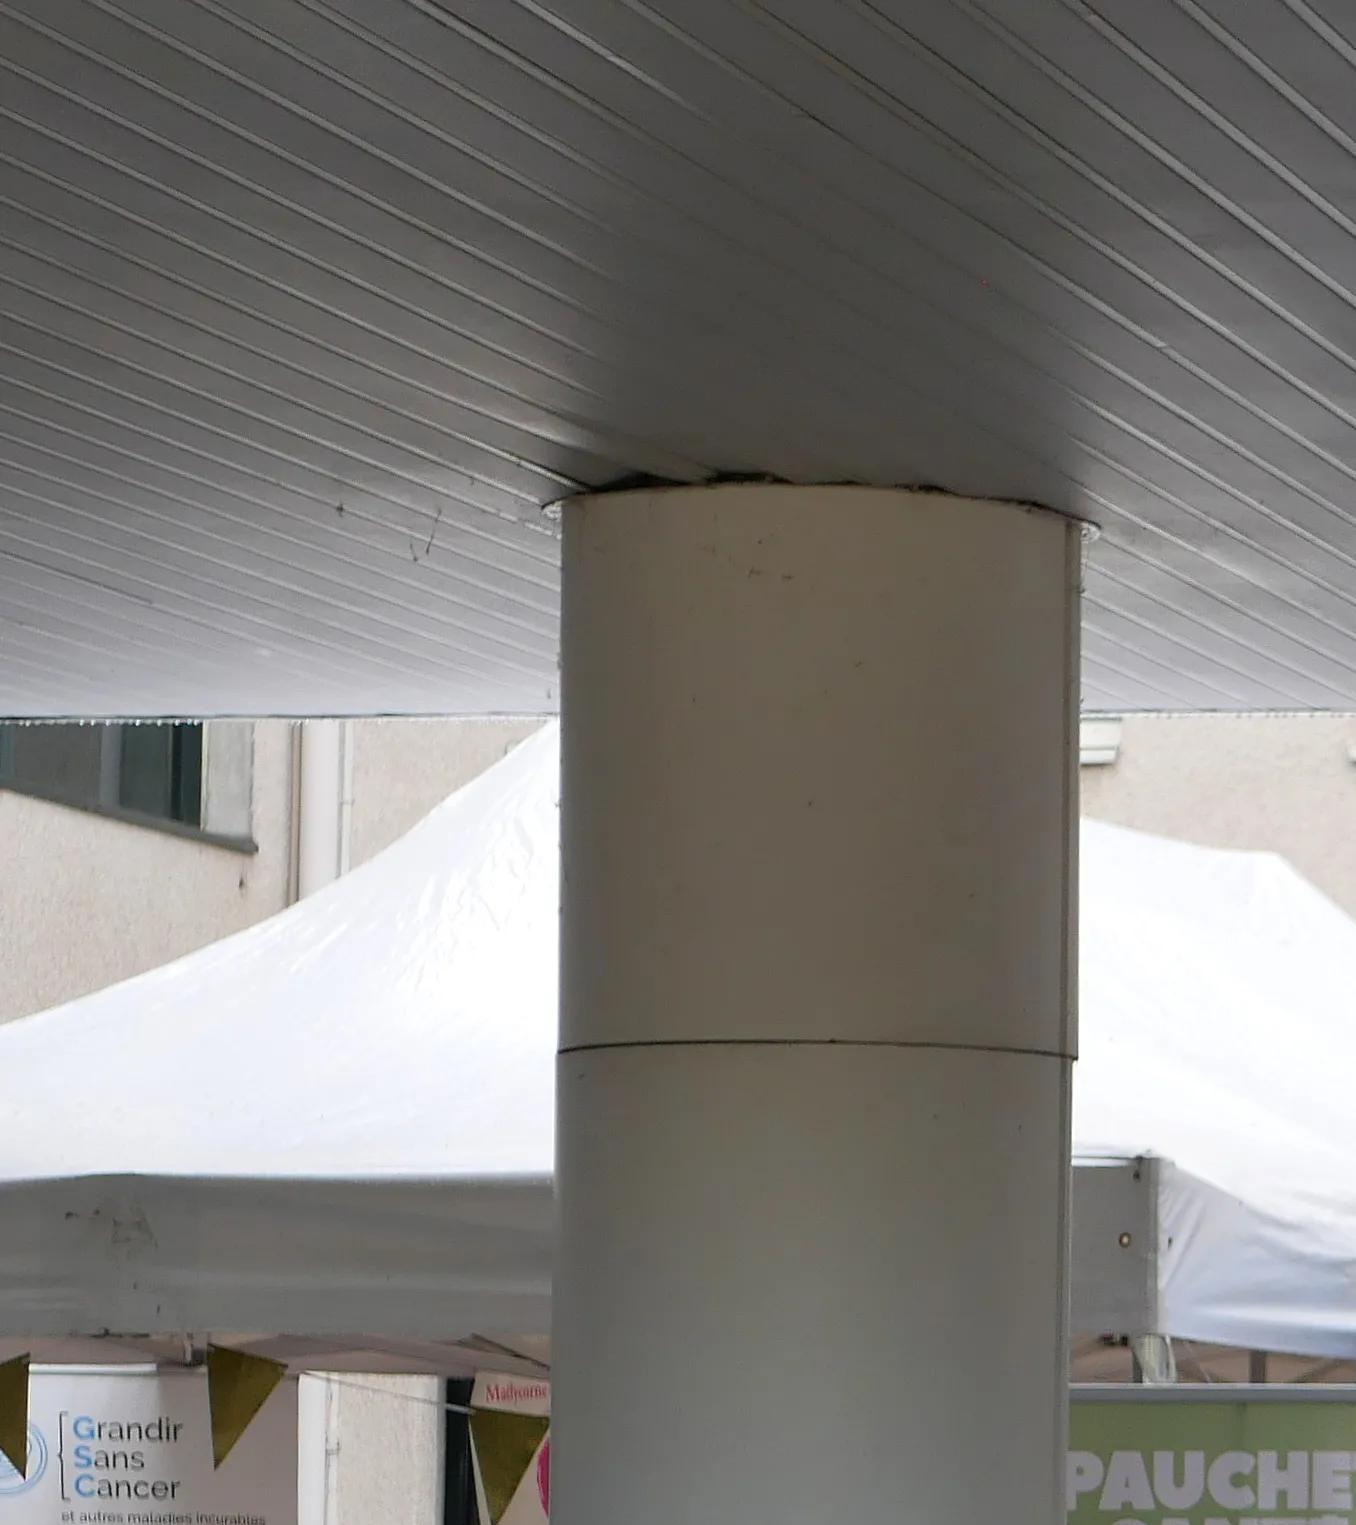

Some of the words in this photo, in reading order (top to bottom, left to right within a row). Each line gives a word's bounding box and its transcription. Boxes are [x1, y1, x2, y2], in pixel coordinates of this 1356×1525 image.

[73, 1415, 183, 1443] Grandir
[74, 1445, 145, 1471] Sans
[74, 1473, 181, 1499] Cancer
[61, 1511, 75, 1523] et
[80, 1511, 123, 1525] autres
[128, 1511, 193, 1525] maladies
